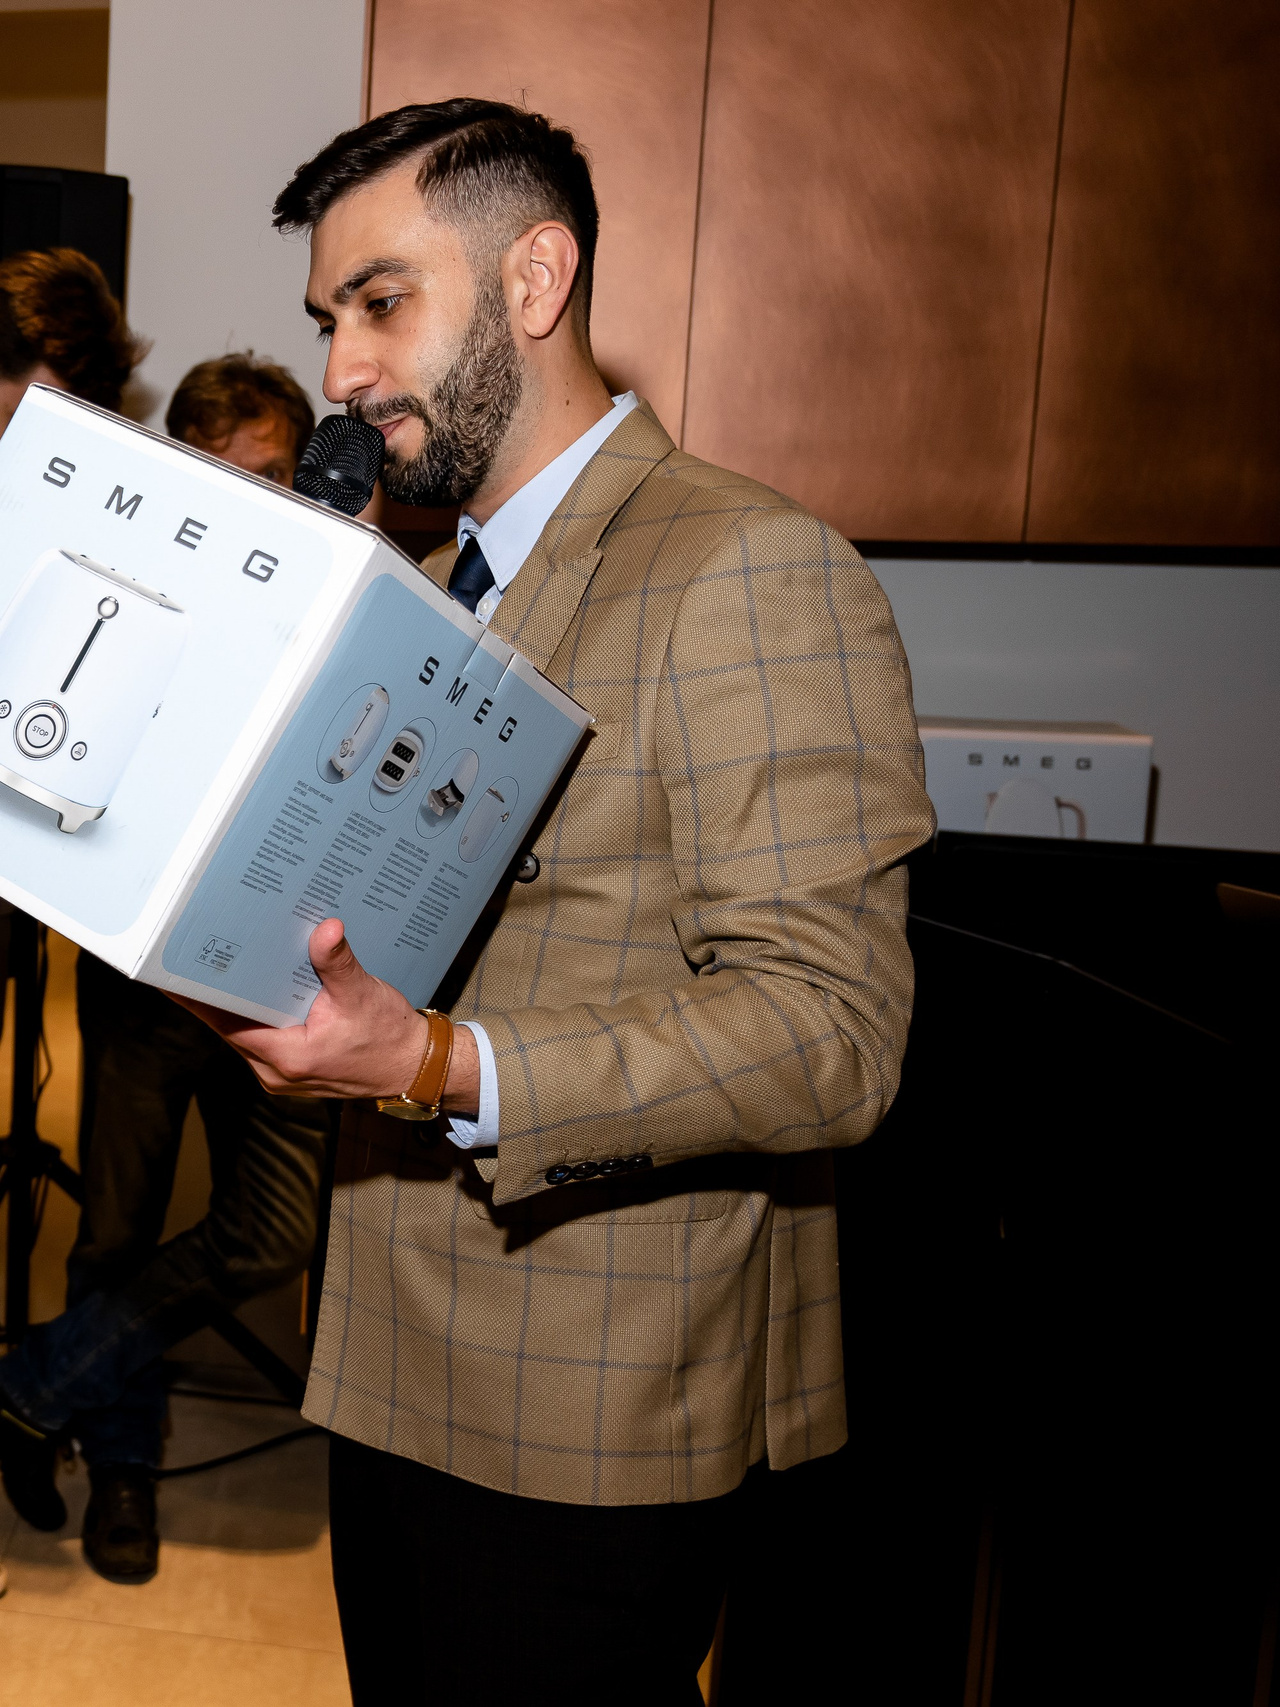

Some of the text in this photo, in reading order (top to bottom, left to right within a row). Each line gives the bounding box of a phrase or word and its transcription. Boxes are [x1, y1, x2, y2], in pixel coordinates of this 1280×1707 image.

[43, 456, 279, 583] SMEG
[418, 655, 518, 743] SMEG
[32, 725, 49, 738] STOP
[967, 753, 1092, 771] SMEG
